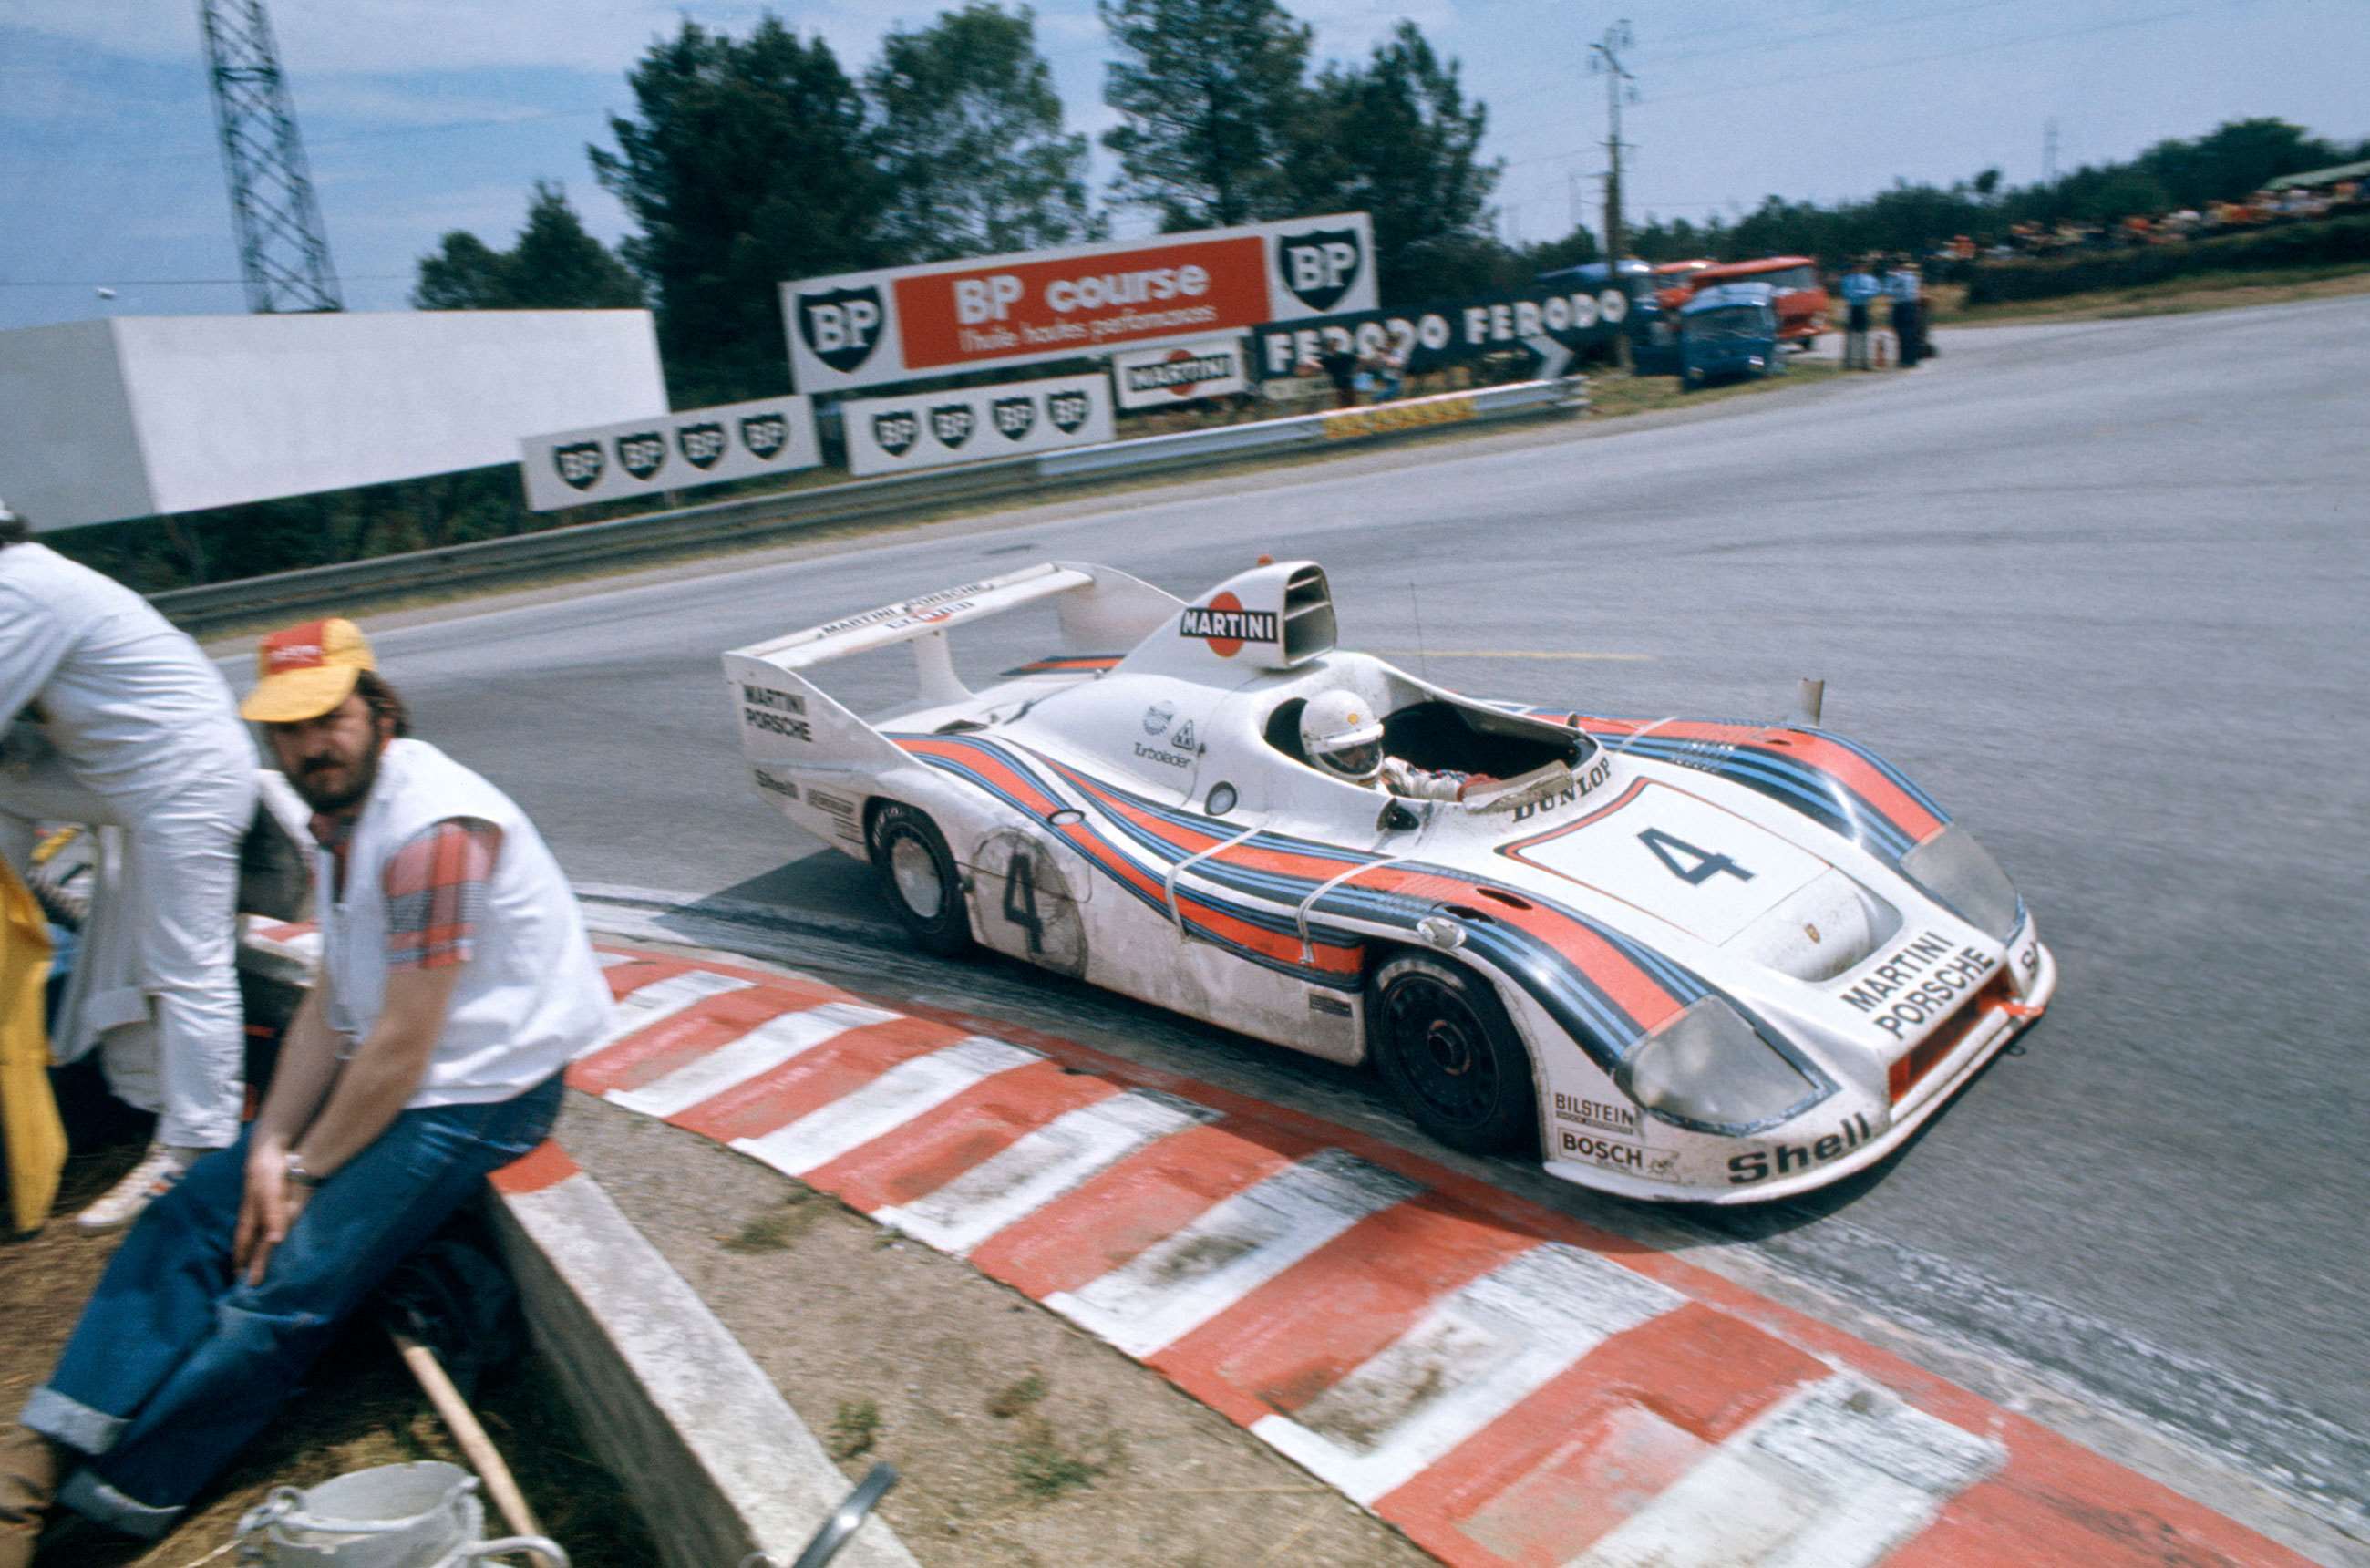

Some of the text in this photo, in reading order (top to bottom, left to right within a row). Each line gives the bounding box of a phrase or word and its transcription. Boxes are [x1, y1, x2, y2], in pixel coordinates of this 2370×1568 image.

[953, 264, 1211, 325] BP course
[1287, 242, 1356, 292] BP
[807, 299, 880, 354] BP
[1463, 289, 1629, 345] FERODO
[1129, 356, 1231, 390] MARTINI
[877, 397, 1088, 447] BP BP BP BP
[559, 420, 788, 480] BP BP BP BP
[822, 608, 898, 634] MARTINI
[1181, 611, 1276, 641] MARTINI
[743, 685, 807, 717] MARTINI
[744, 707, 813, 743] PORSCHE
[1512, 757, 1612, 824] DUNLOP
[1636, 827, 1759, 888] 4
[1003, 852, 1045, 955] 4
[1839, 930, 1955, 1014] MARTINI
[1874, 947, 1995, 1040] PORSCHE
[1555, 1092, 1634, 1126] BILSTEIN
[1562, 1132, 1643, 1171] BOSCH
[1727, 1111, 1870, 1184] Shell
